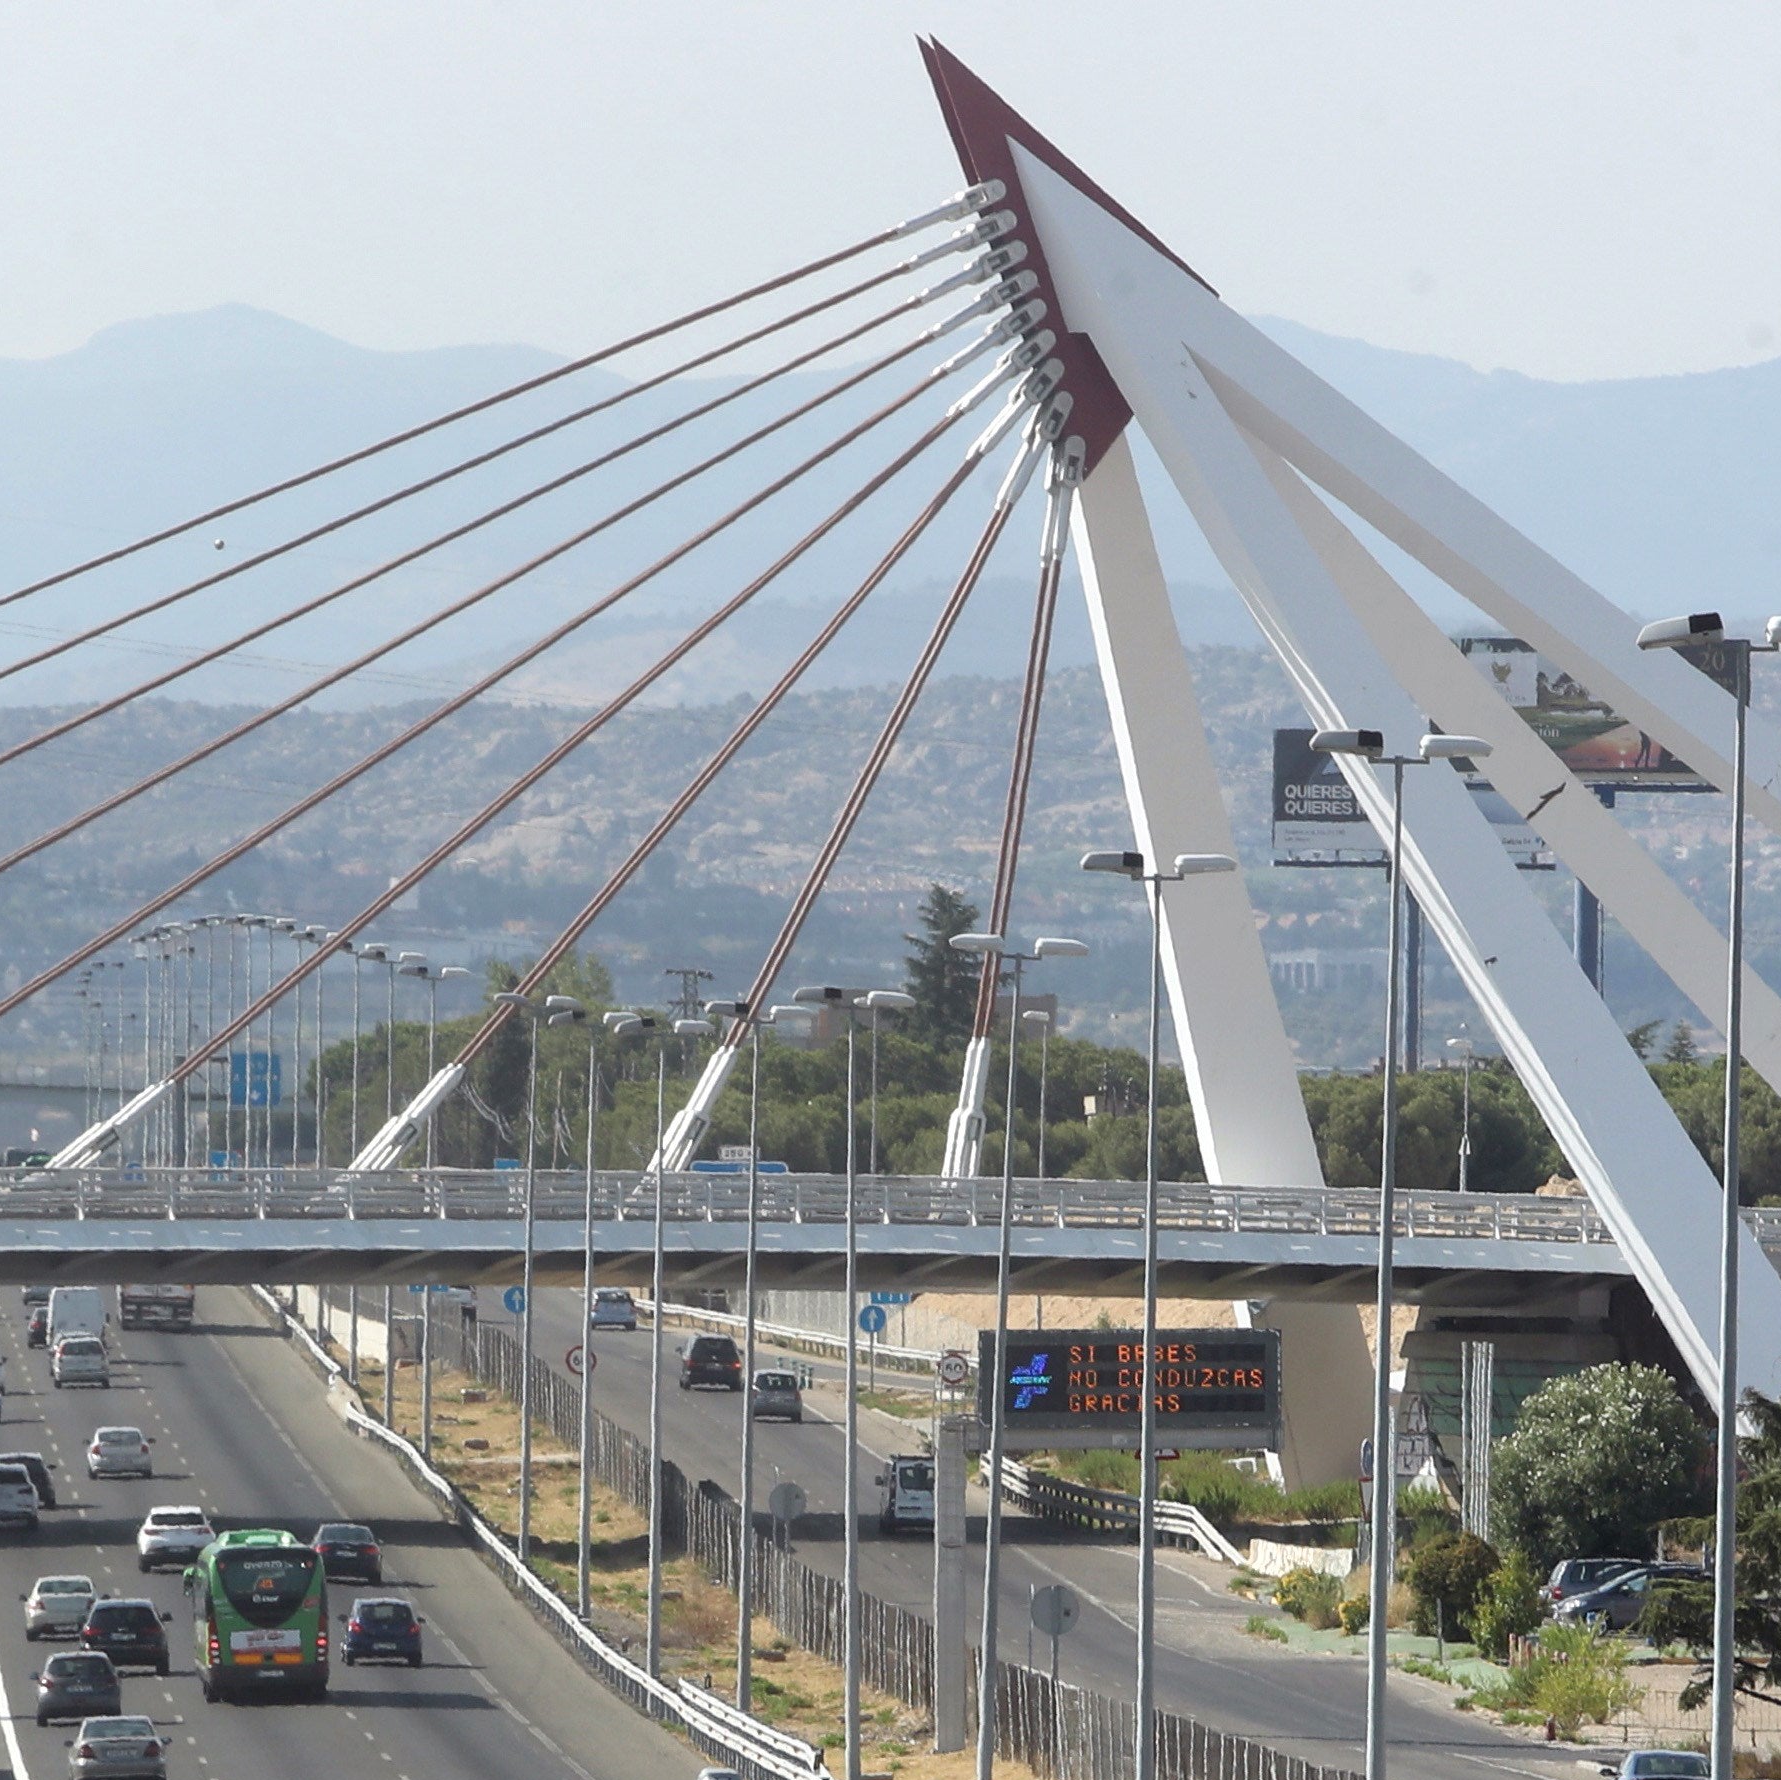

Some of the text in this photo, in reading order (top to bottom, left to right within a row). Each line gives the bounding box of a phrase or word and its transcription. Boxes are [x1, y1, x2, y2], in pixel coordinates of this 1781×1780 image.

[1284, 785, 1353, 799] QUIERES
[1284, 801, 1353, 815] QUIERES
[1069, 1346, 1096, 1363] SI
[1069, 1369, 1098, 1387] NO
